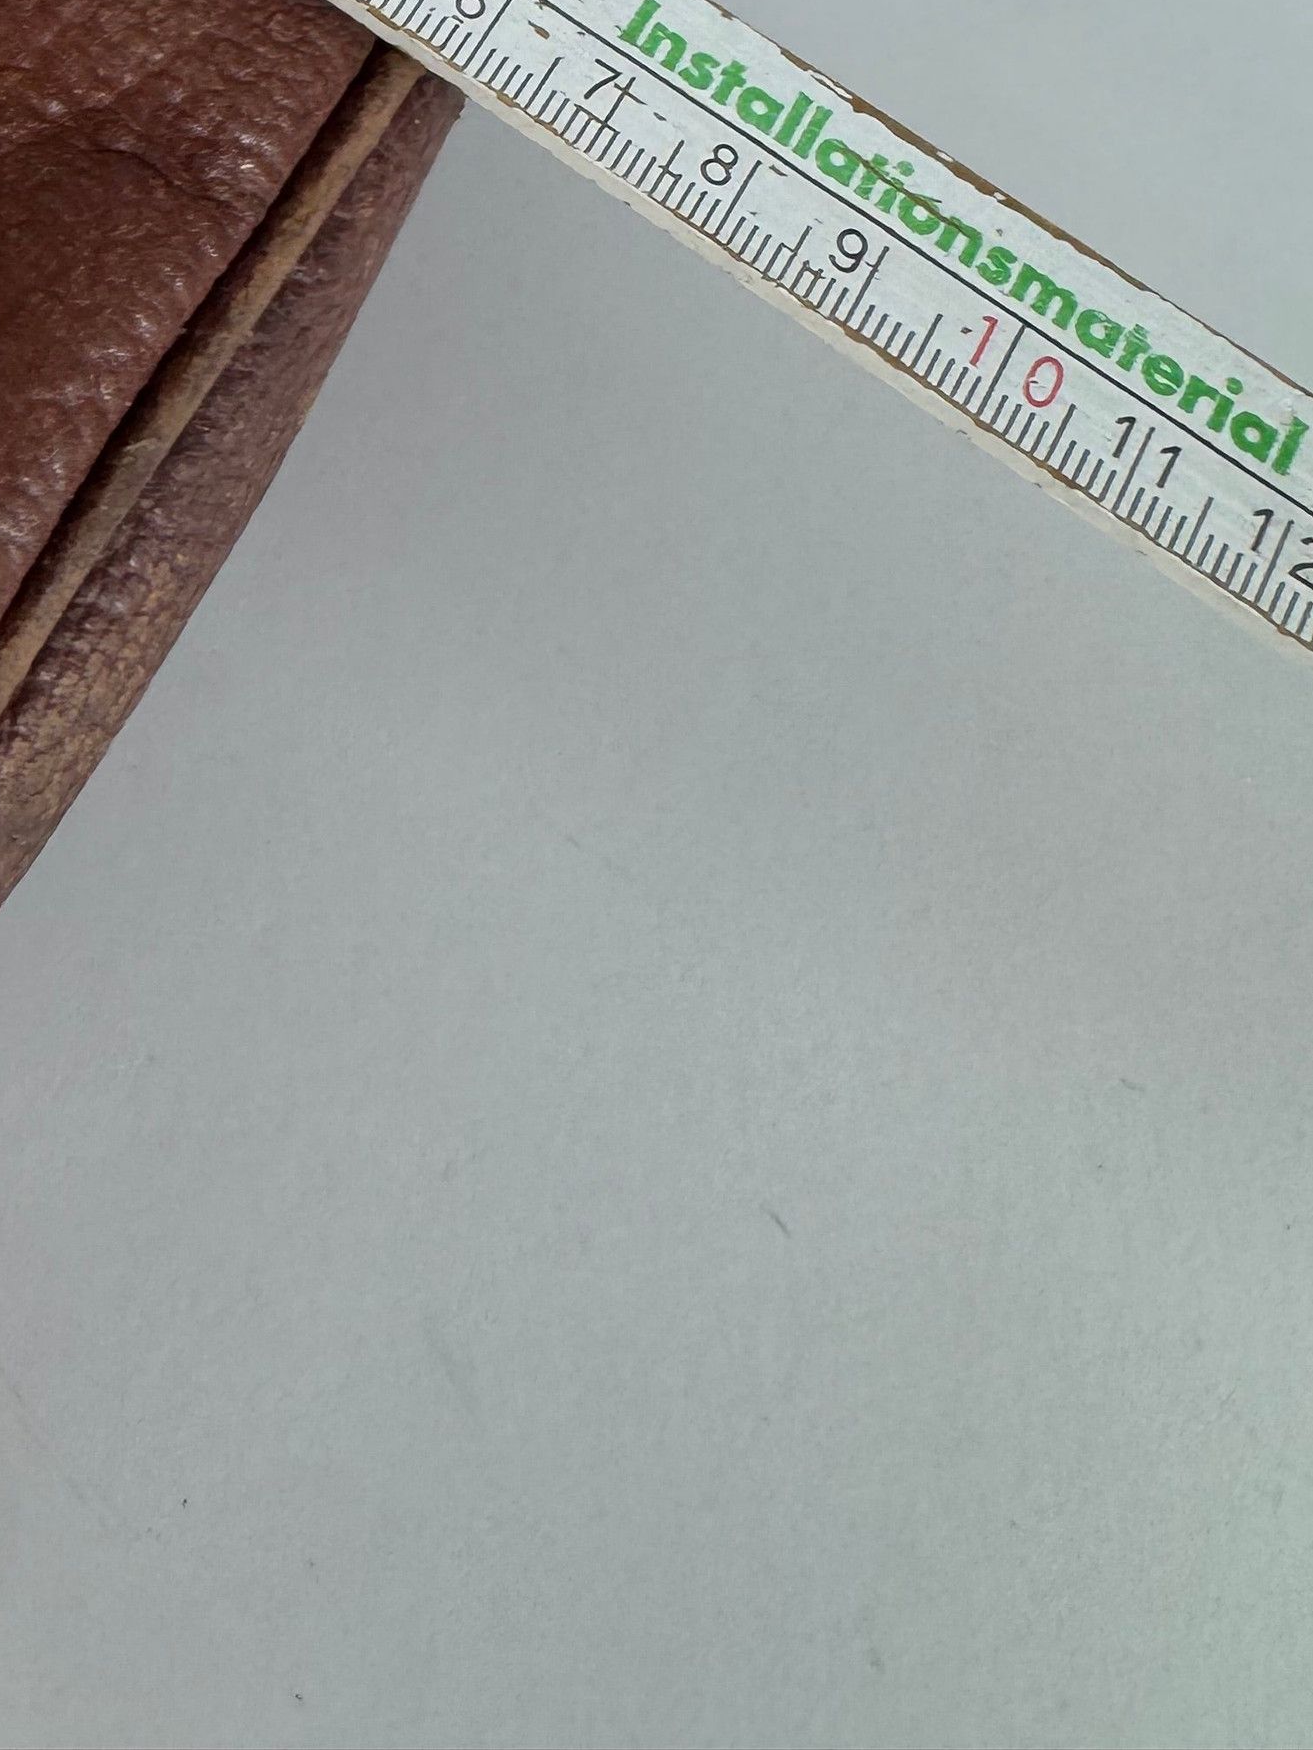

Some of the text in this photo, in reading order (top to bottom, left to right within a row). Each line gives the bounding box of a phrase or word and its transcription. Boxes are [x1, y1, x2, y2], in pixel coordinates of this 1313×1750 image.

[584, 58, 623, 100] 7
[700, 143, 739, 186] 8
[829, 228, 869, 273] 9
[969, 315, 1064, 408] 10
[1112, 416, 1183, 489] 11
